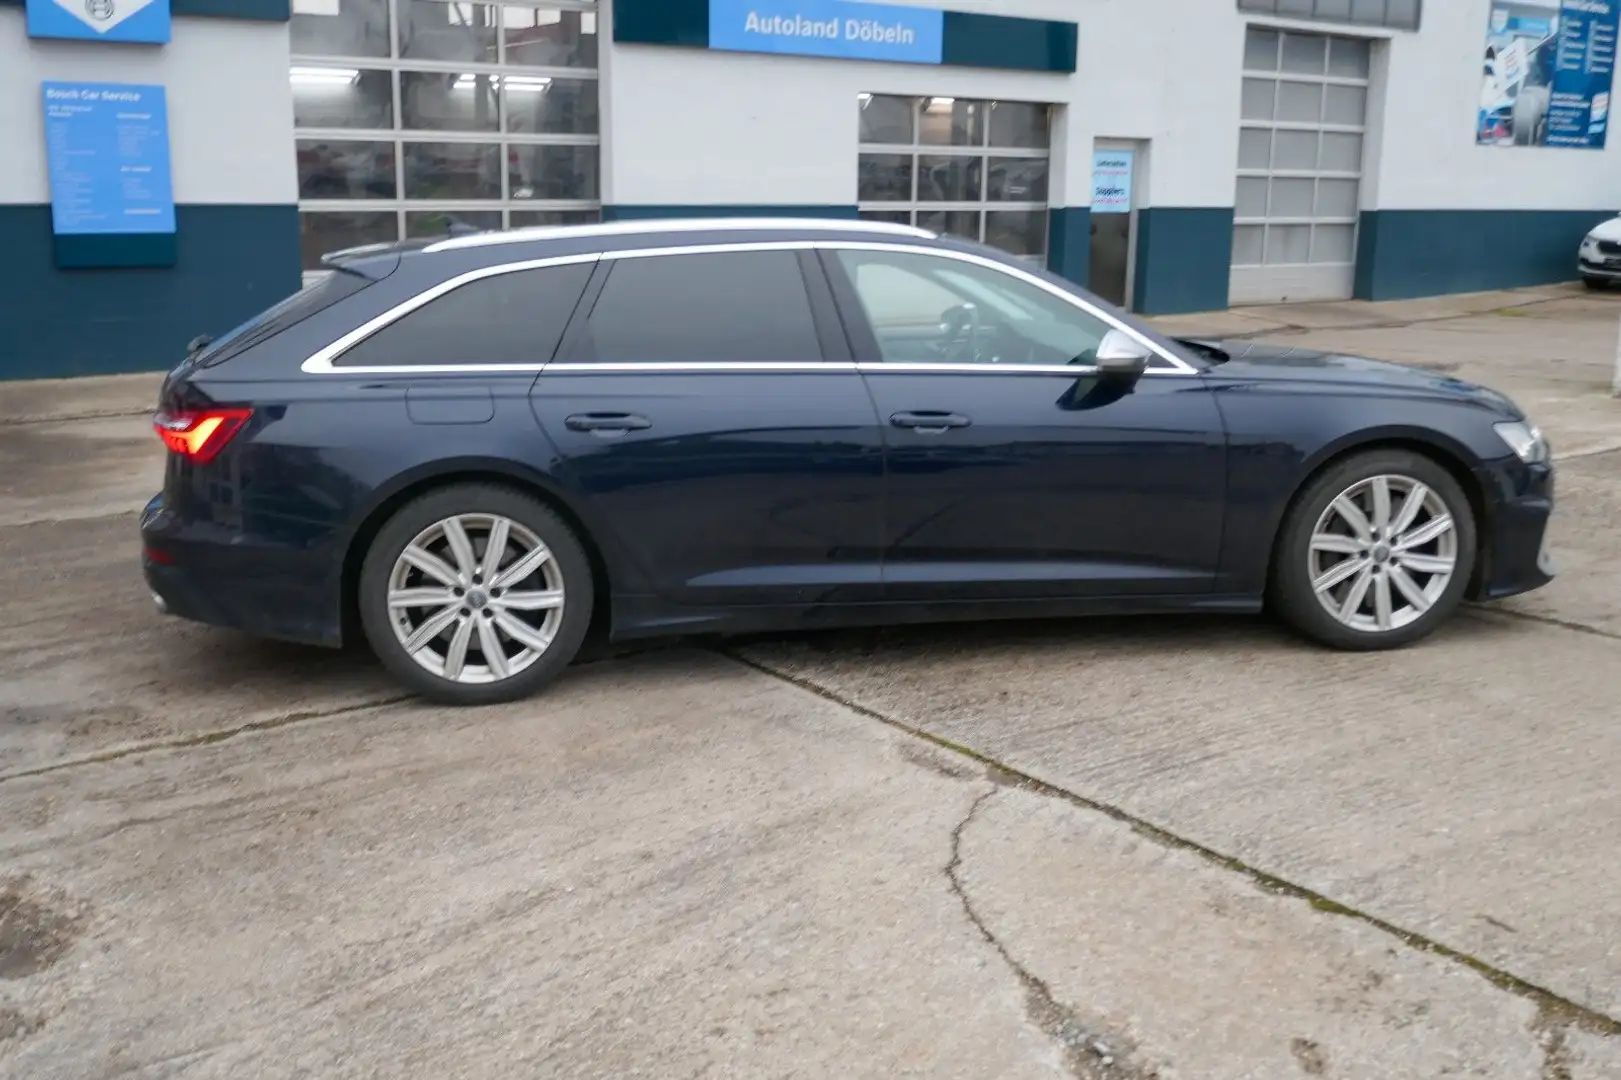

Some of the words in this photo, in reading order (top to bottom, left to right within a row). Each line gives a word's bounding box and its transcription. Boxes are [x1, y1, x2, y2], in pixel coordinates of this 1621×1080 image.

[745, 11, 839, 39] Autoland
[845, 19, 915, 44] Döbeln
[101, 90, 142, 103] Service
